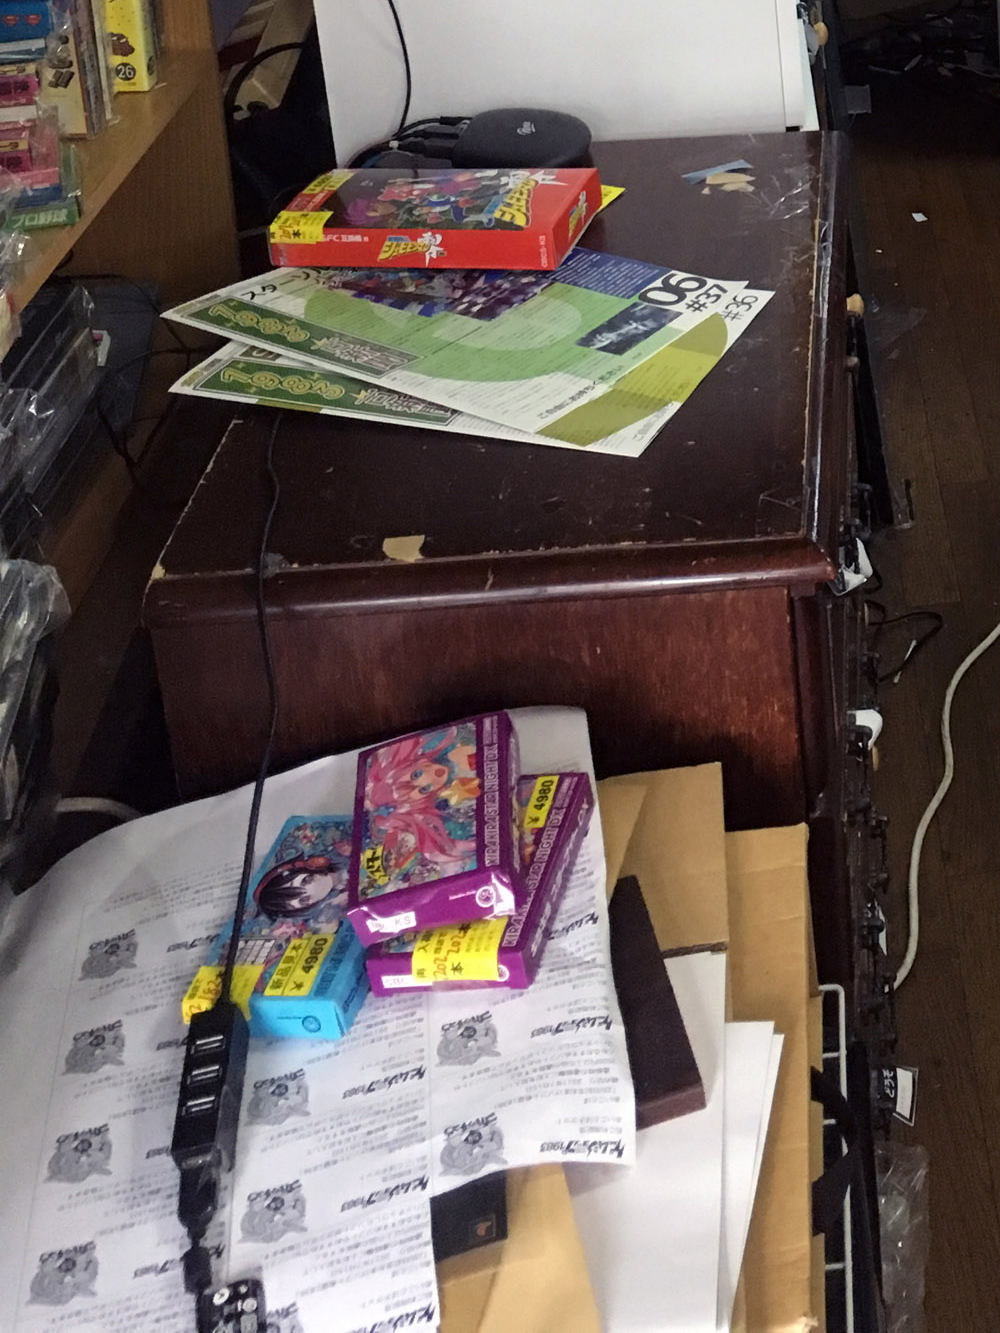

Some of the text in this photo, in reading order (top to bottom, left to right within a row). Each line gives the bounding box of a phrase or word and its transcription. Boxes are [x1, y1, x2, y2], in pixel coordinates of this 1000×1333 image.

[119, 66, 134, 79] 26
[685, 283, 729, 313] #37
[720, 294, 759, 322] #36
[208, 304, 310, 343] 1983
[221, 368, 346, 400] 1983
[533, 779, 555, 812] 4980
[301, 937, 329, 975] 4980
